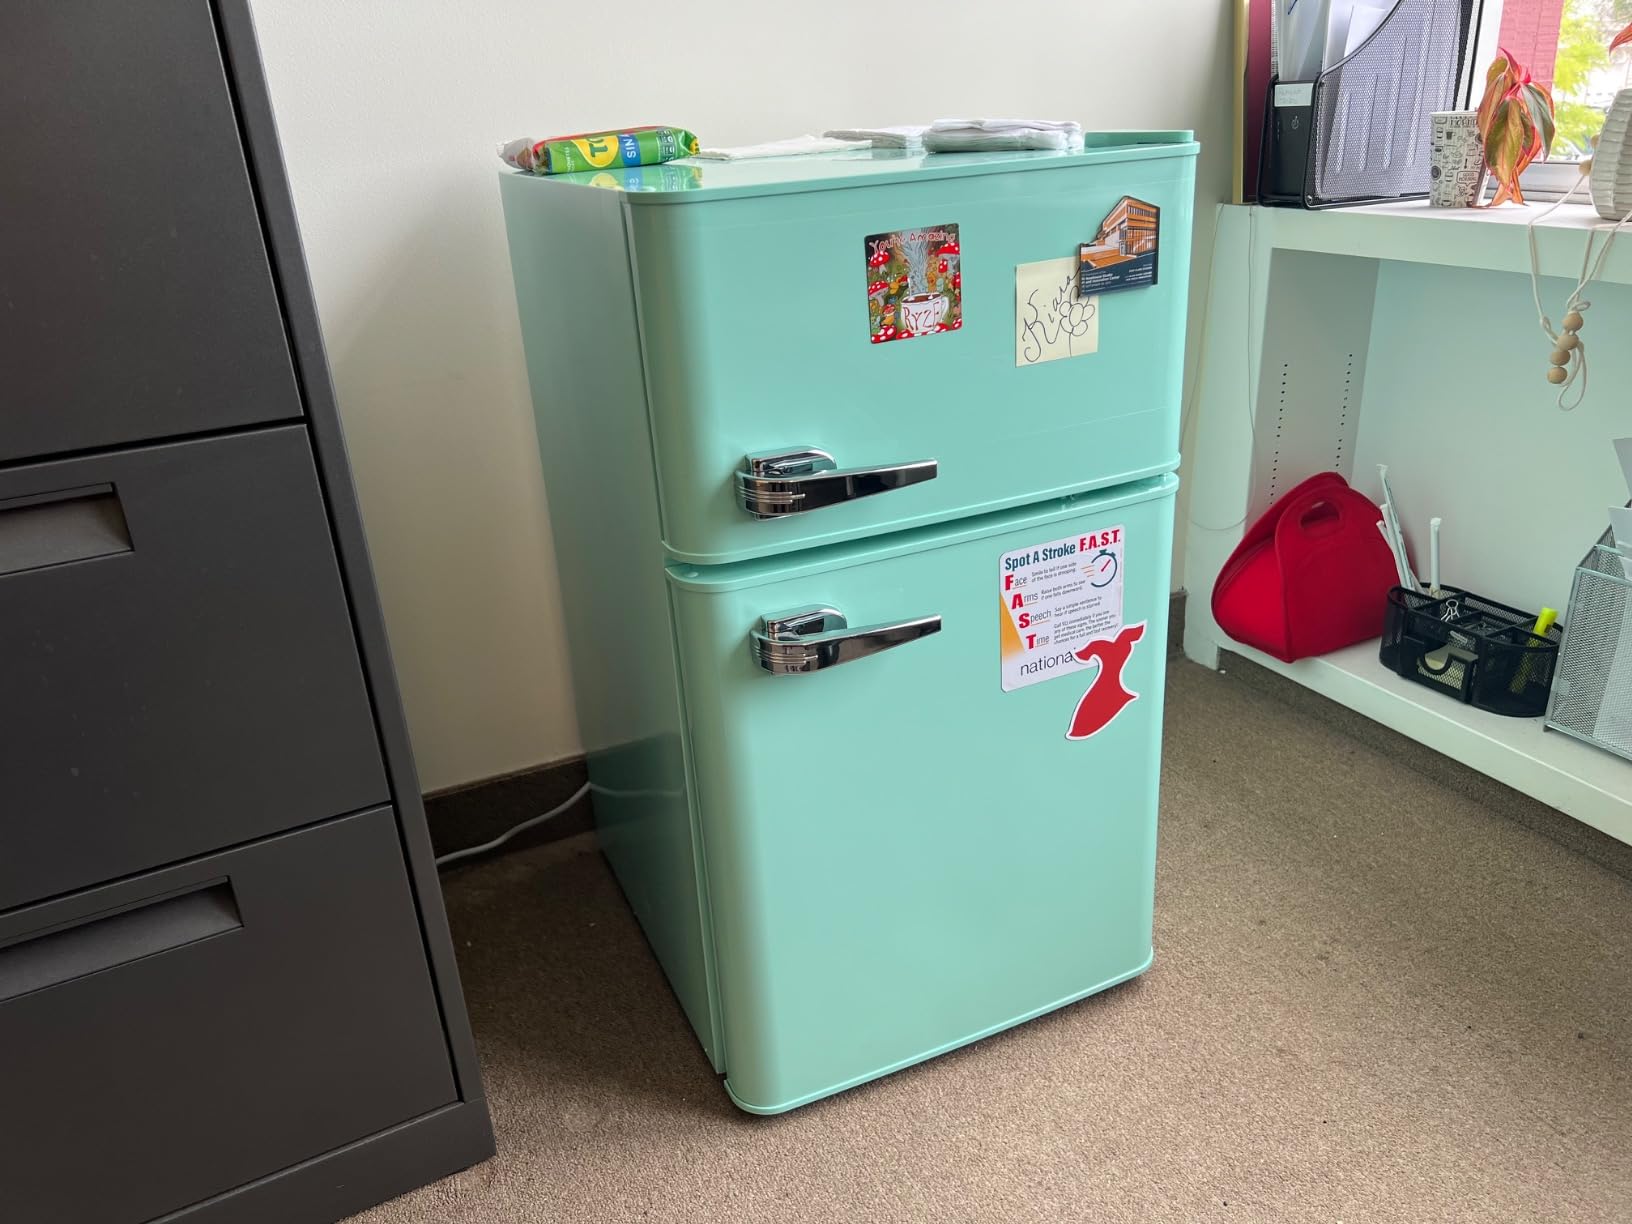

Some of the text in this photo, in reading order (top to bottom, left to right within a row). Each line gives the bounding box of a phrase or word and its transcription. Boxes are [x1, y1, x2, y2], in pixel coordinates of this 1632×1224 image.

[909, 230, 956, 243] Amazing
[1005, 529, 1121, 572] Spot A Stroke F.A.S.T.
[1004, 574, 1028, 591] Face
[1011, 593, 1039, 609] Arms
[1018, 610, 1052, 629] Speech
[1026, 634, 1049, 650] Time
